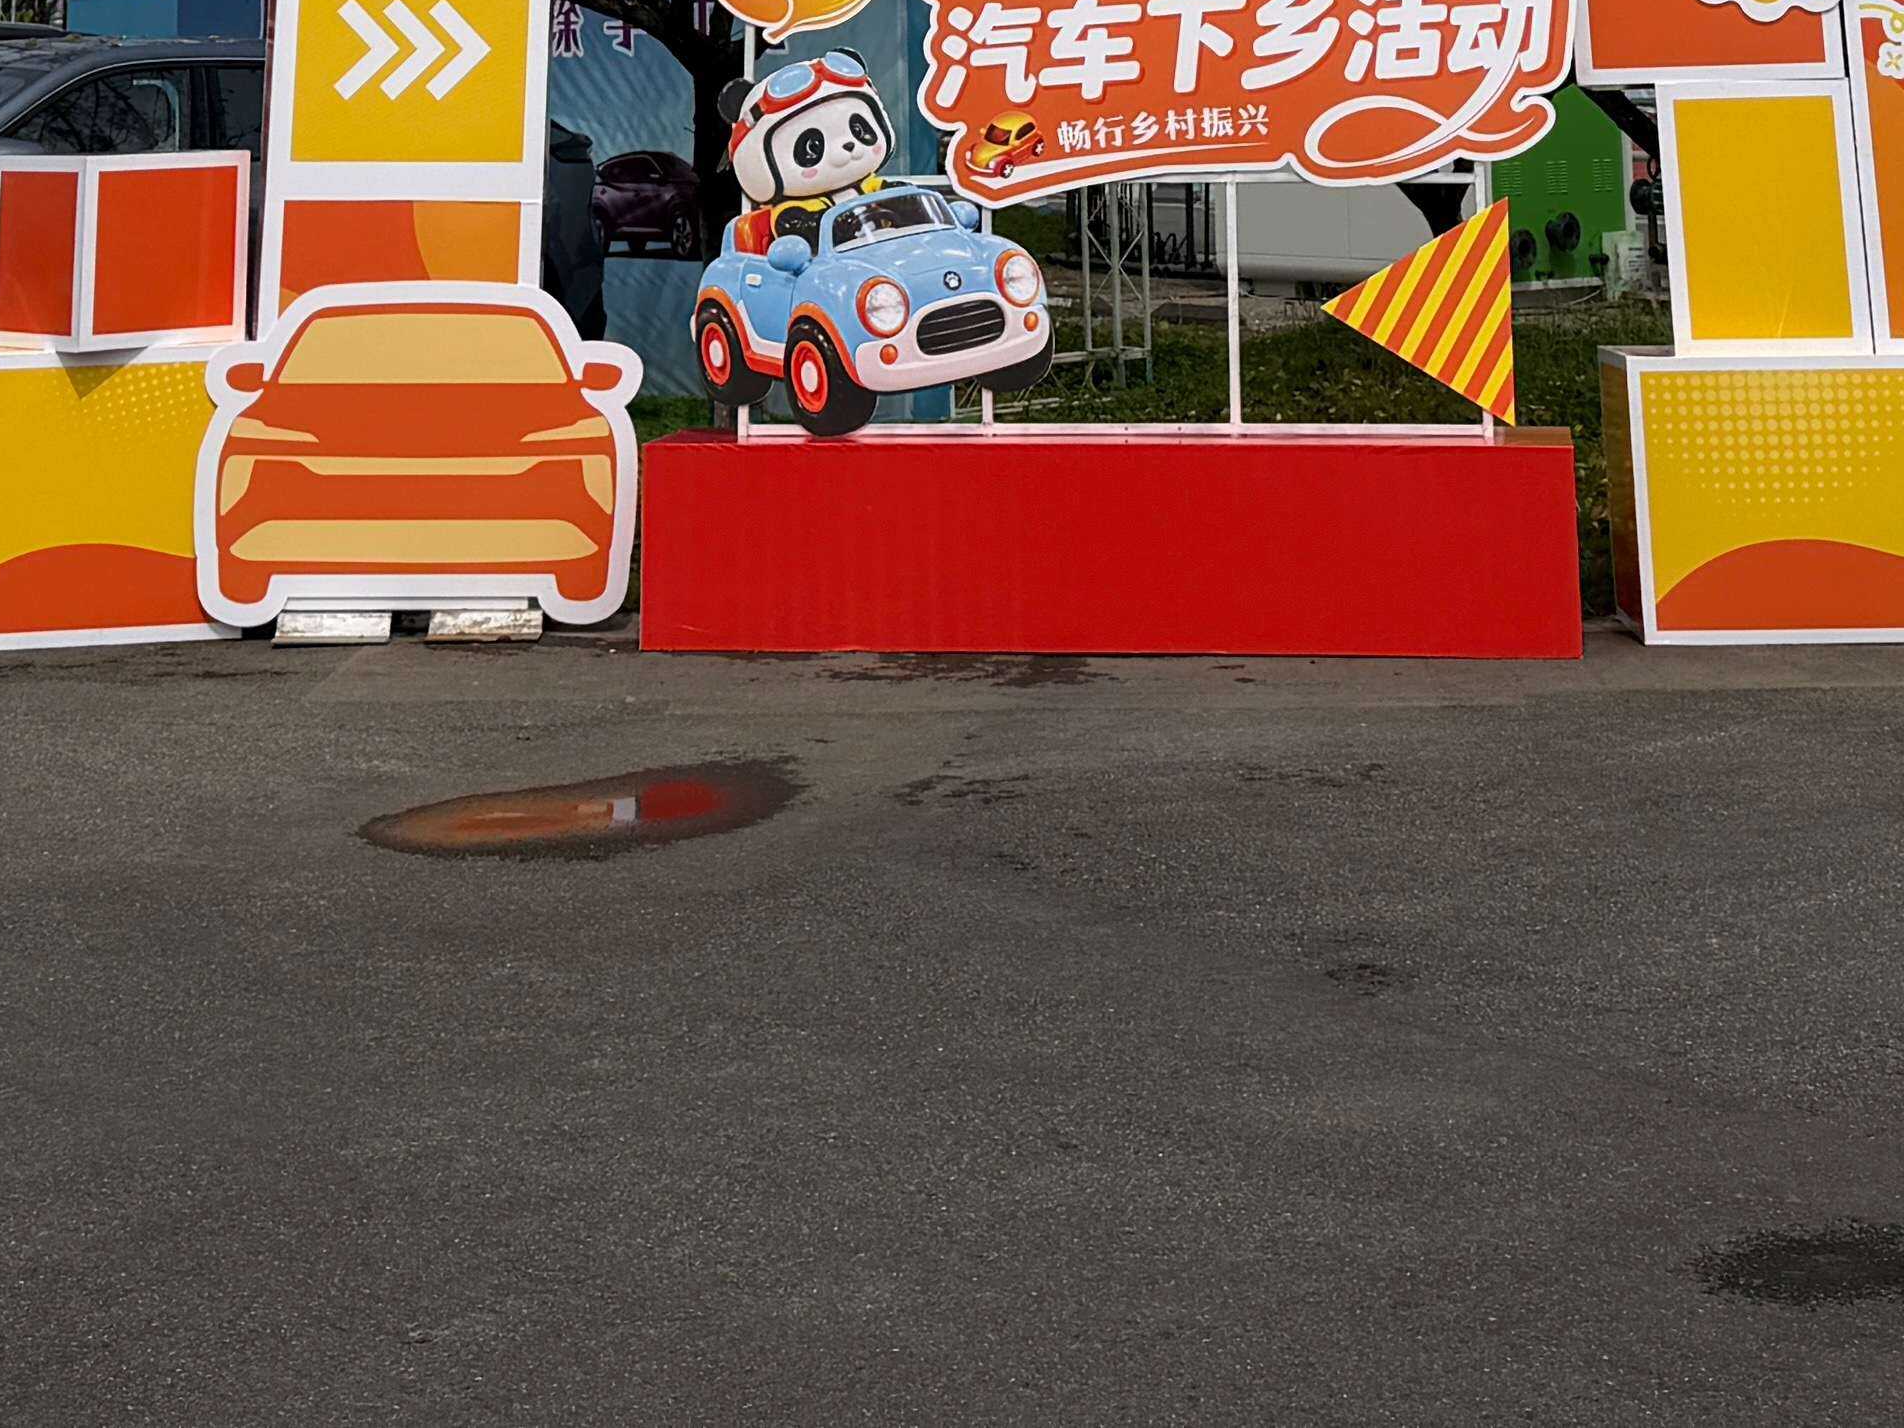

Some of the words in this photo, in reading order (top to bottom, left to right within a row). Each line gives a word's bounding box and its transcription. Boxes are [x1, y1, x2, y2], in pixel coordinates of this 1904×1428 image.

[1056, 103, 1271, 150] 畅行乡村振兴
